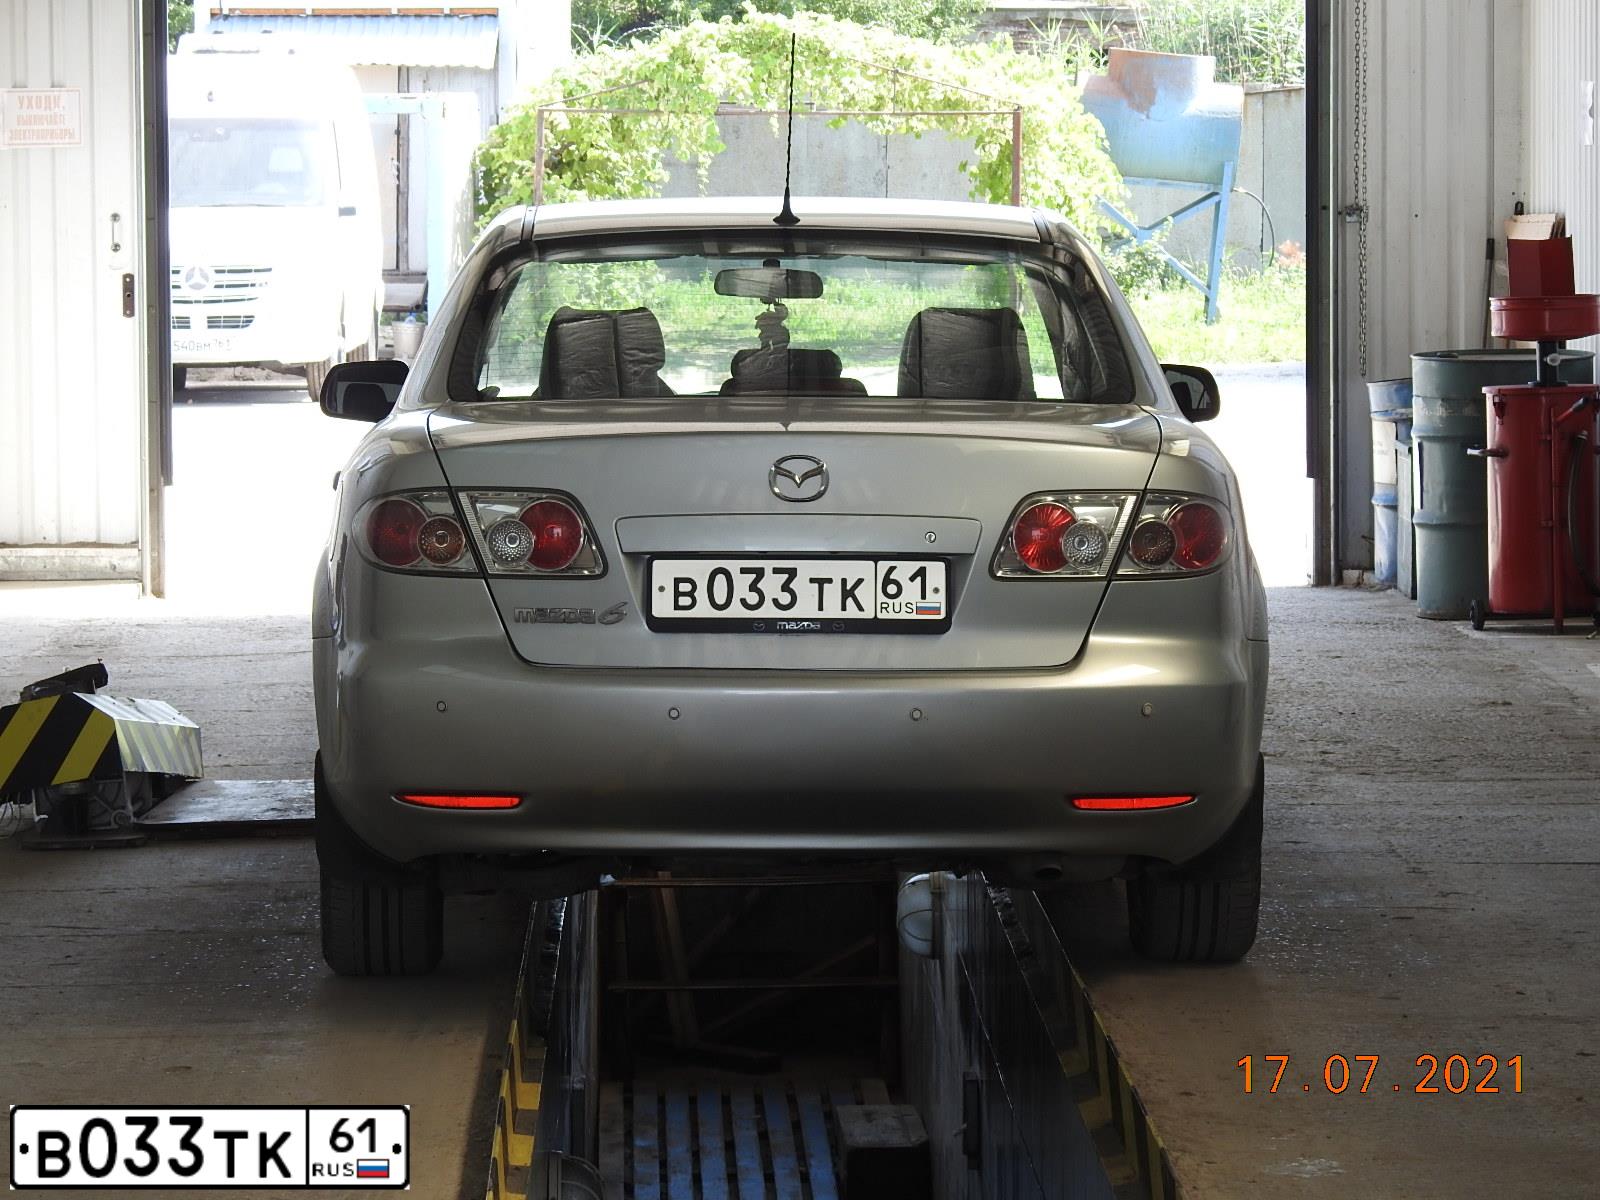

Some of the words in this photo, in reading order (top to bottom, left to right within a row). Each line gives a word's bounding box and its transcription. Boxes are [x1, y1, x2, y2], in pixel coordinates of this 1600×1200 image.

[881, 565, 927, 600] 61
[598, 601, 628, 625] 6
[880, 602, 914, 614] RUS
